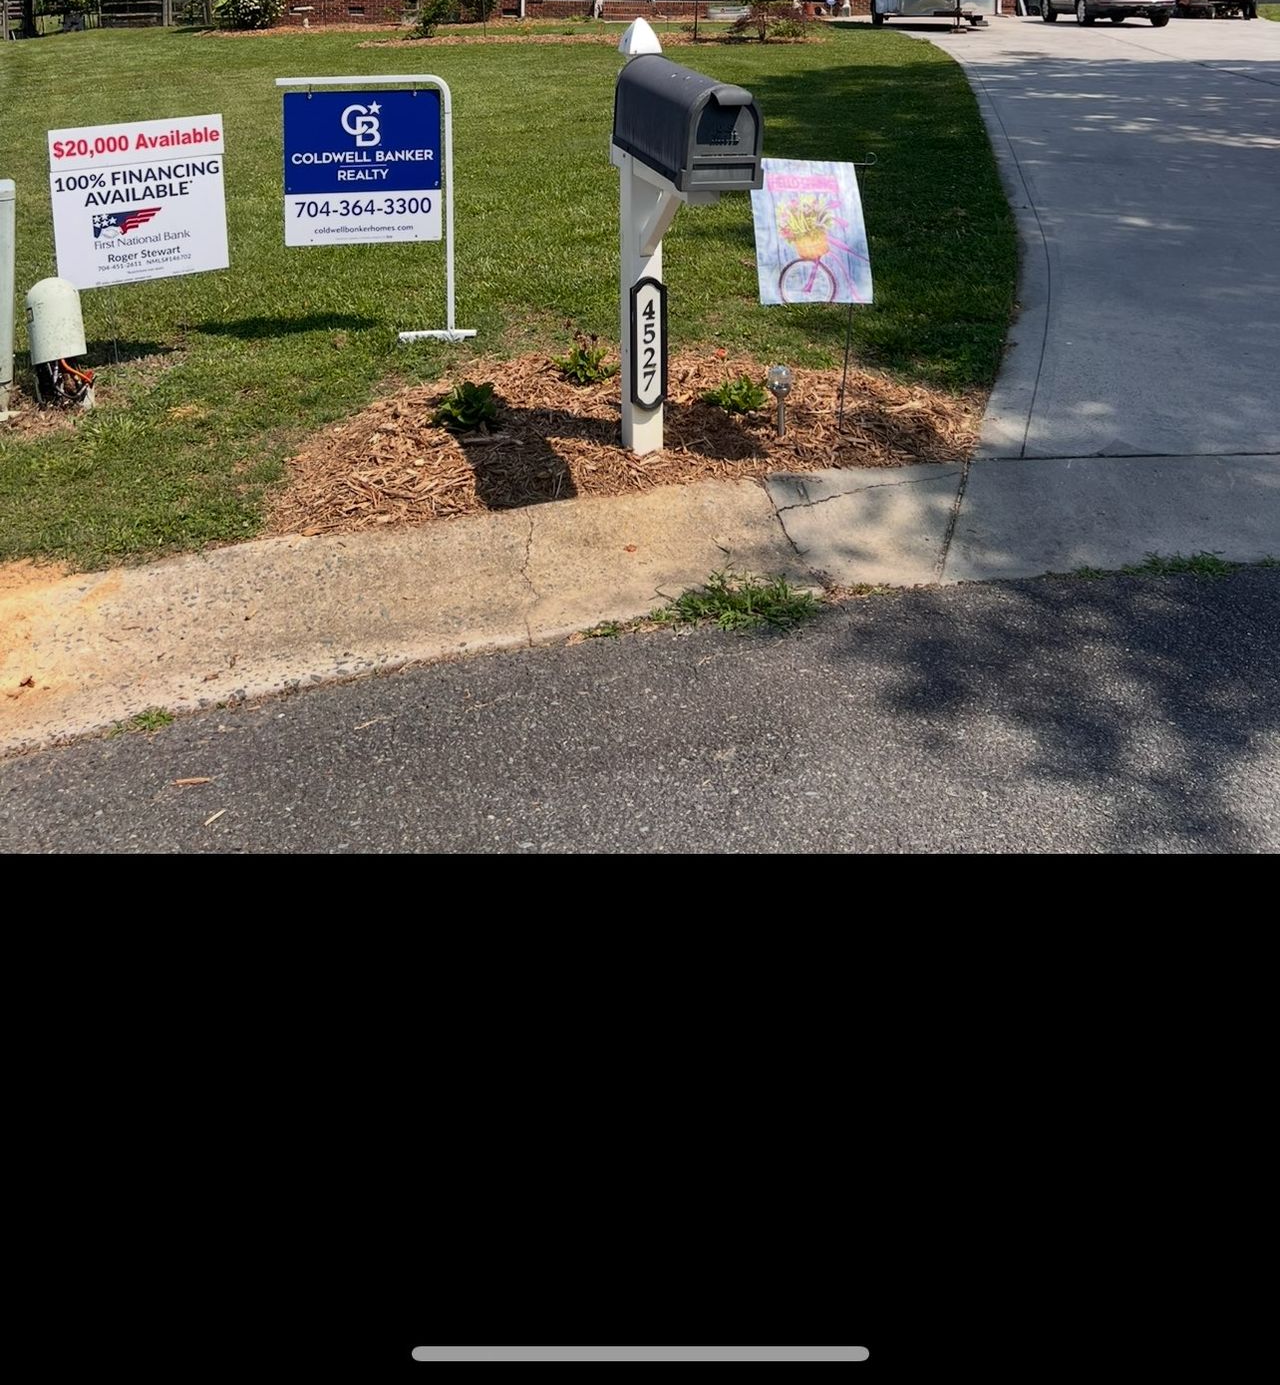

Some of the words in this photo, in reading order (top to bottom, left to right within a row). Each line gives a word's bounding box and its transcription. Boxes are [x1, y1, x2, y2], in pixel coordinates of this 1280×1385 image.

[53, 135, 129, 160] $20,000
[135, 127, 220, 150] Available
[291, 151, 372, 165] COLDWELL
[375, 149, 434, 162] BANKER
[54, 173, 107, 193] 100%
[111, 160, 219, 186] FINANCING
[337, 168, 389, 181] REALTY
[295, 197, 432, 218] 704-364-3300
[314, 223, 414, 234] coldwellbankerhomes.com
[94, 240, 115, 250] First
[117, 234, 161, 247] National
[164, 229, 191, 241] Bank
[108, 252, 138, 264] Roger
[141, 245, 181, 258] Stewart
[642, 299, 657, 392] 4527
